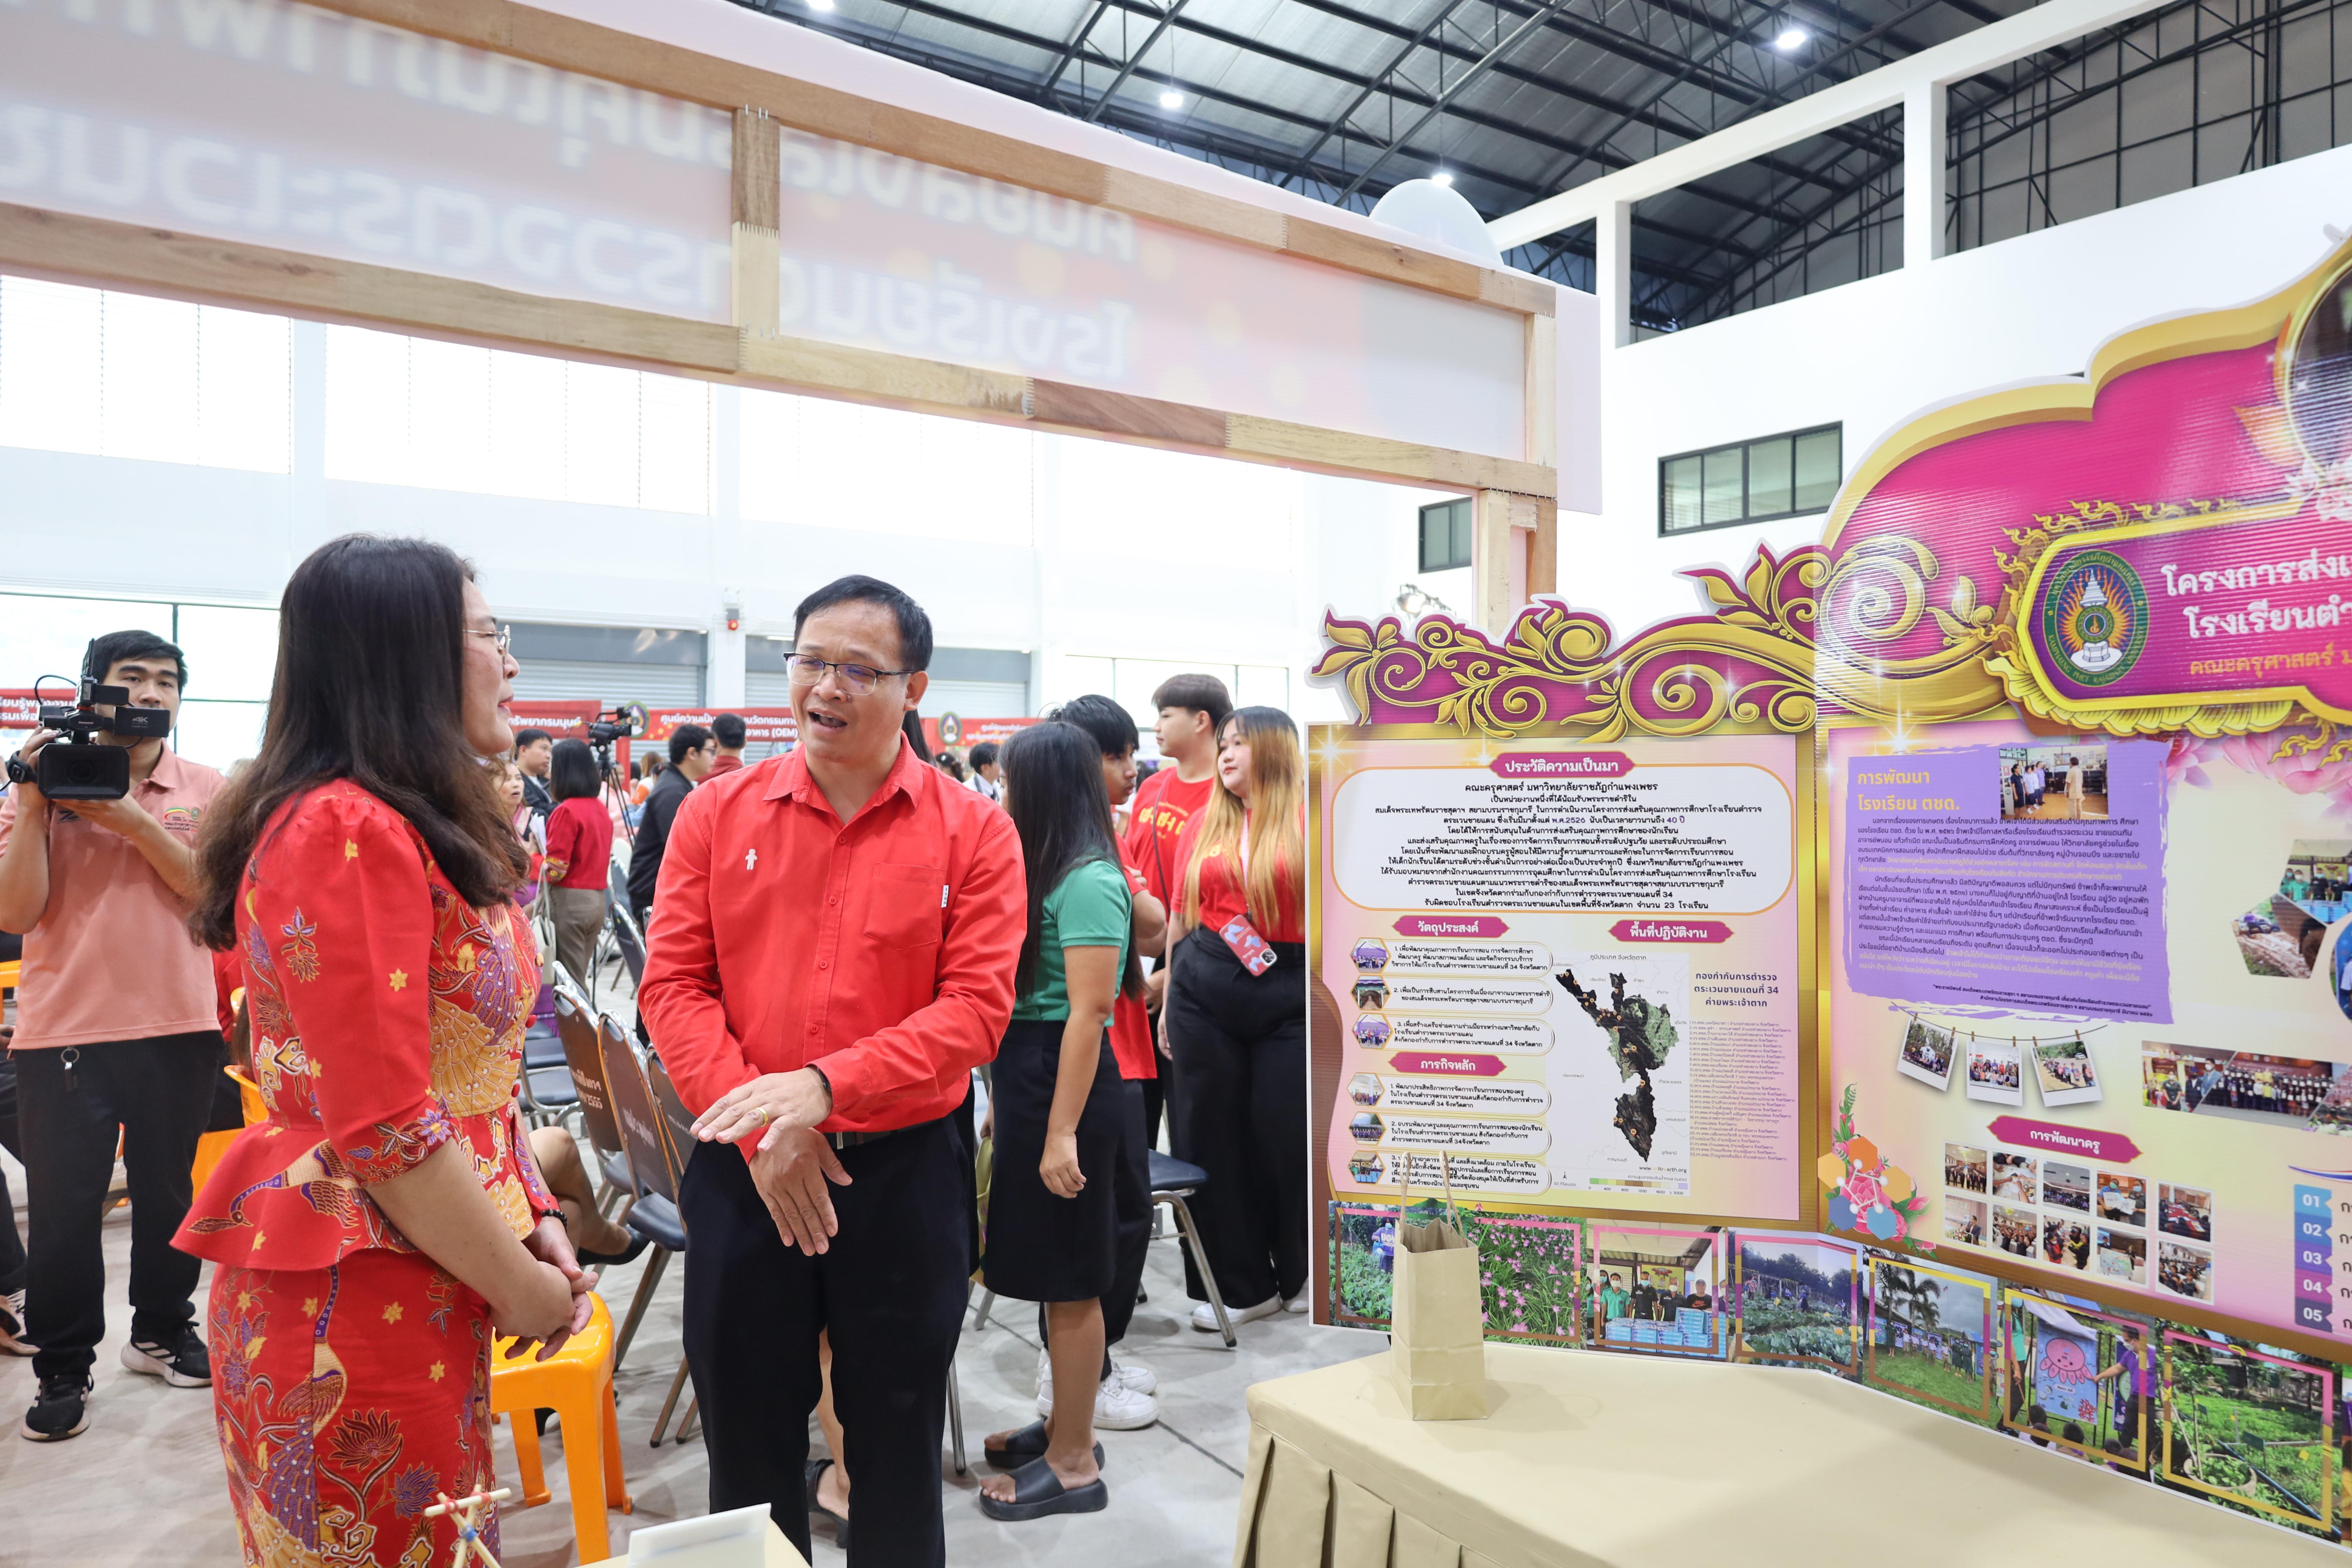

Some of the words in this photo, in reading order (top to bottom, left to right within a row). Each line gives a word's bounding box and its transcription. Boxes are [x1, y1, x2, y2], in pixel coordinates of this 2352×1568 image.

[2161, 547, 2352, 596] โครงการส่งเ
[772, 728, 798, 738] (OEM)
[1505, 758, 1619, 776] ประวัติความเป็นมา
[1857, 769, 1930, 785] การพัฒนา
[1465, 781, 1524, 794] คณะครุศาสตร์
[1527, 781, 1658, 792] มหาวิทยาลัยราชภัฏกำแพงเพชร
[1491, 794, 1637, 803] เป็นหน่วยงานหนึ่งที่ได้น้อมรับพระราชดำริใน
[1857, 794, 1917, 811] โรงเรียน
[1922, 797, 1960, 810] ตชด.
[1375, 805, 1465, 815] สมเด็จพระเทพรัตนราชสุดาฯ
[1469, 805, 1532, 815] สยามบรมราชกุมารี
[1537, 805, 1762, 815] ในการดำเนินงานโครงการส่งเสริมคุณภาพการศึกษาโรงเรียนตำรวจ
[1498, 813, 1550, 824] ซึ่งเริ่มมีมาตั้งแต่
[1589, 815, 1664, 824] นับเป็นเวลายาวนานถึง
[1873, 816, 1944, 824] นอกจากเรื่องของการเกษตร
[1945, 816, 1998, 824] เรื่องโภชนาการแล้ว
[1448, 826, 1678, 836] โดยได้ให้การสนับสนุนในด้านการส่งเสริมคุณภาพการศึกษาของนักเรียน
[1956, 827, 2093, 836] ข้าพเจ้ามีโอกาสหารือเรื่องโรงเรียนตำรวจตระเวน
[1407, 835, 1647, 847] และส่งเสริมคุณภาพครูในเรื่องของการจัดการเรียนการสอนทั้งระดับปฐมวัย
[1649, 837, 1726, 845] และระดับประถมศึกษา
[2061, 838, 2139, 848] ให้วิทยาลัยครูช่วยในเรื่อง
[1858, 847, 1925, 855] อบรมเทคนิคการสอนแก่ครู
[1998, 848, 2054, 858] เริ่มต้นที่วิทยาลัยครู
[1875, 875, 1958, 885] นักเรียนที่จบชั้นประถมศึกษาแล้ว
[1959, 878, 2026, 888] มีสติปัญญาดีพอสมควร
[2028, 880, 2076, 890] แต่ไม่มีทุนทรัพย์
[2070, 893, 2096, 901] โรงเรียน
[2098, 895, 2116, 904] อยู่วัด
[1679, 900, 1708, 909] โรงเรียน
[1858, 904, 1903, 913] จ่ายทั้งค่าเล่าเรียน
[1928, 906, 1952, 915] ค่าเสื้อผ้า
[2034, 902, 2081, 912] ศึกษาสงเคราะห์
[1418, 920, 1479, 936] วัตถุประสงค์
[1630, 921, 1707, 940] พื้นที่ปฏิบัติงาน
[1400, 946, 1489, 954] เพื่อพัฒนาคุณภาพการเรียนการสอน
[2130, 951, 2144, 960] เป็น
[1391, 961, 1508, 970] วิชาการให้แก่โรงเรียนตำรวจตระเวนชายแดนที่
[1695, 972, 1777, 982] กองกำกับการตำรวจ
[1694, 983, 1765, 994] ตระเวนชายแดนที่
[1706, 997, 1767, 1007] ค่ายพระเจ้าตาก
[1394, 1028, 1473, 1037] โรงเรียนตำรวจตระเวนชายแดน
[1395, 1036, 1504, 1046] สังกัดกองกำกับการตำรวจตระเวนชายแดนที่
[1420, 1057, 1476, 1071] ภารกิจหลัก
[1392, 1127, 1478, 1137] ในโรงเรียนตำรวจตระเวนชายแดน
[1392, 1136, 1453, 1144] ตำรวจตระเวนชายแดนที่
[2030, 1129, 2101, 1155] การพัฒนาครู
[1456, 1158, 1495, 1166] และสิ่งแวดล้อม
[1496, 1160, 1536, 1168] ภายในโรงเรียน
[2302, 1194, 2320, 1208] 01
[2303, 1222, 2323, 1236] 02
[2303, 1250, 2322, 1265] 03
[2303, 1279, 2323, 1294] 04
[2303, 1307, 2323, 1322] 05
